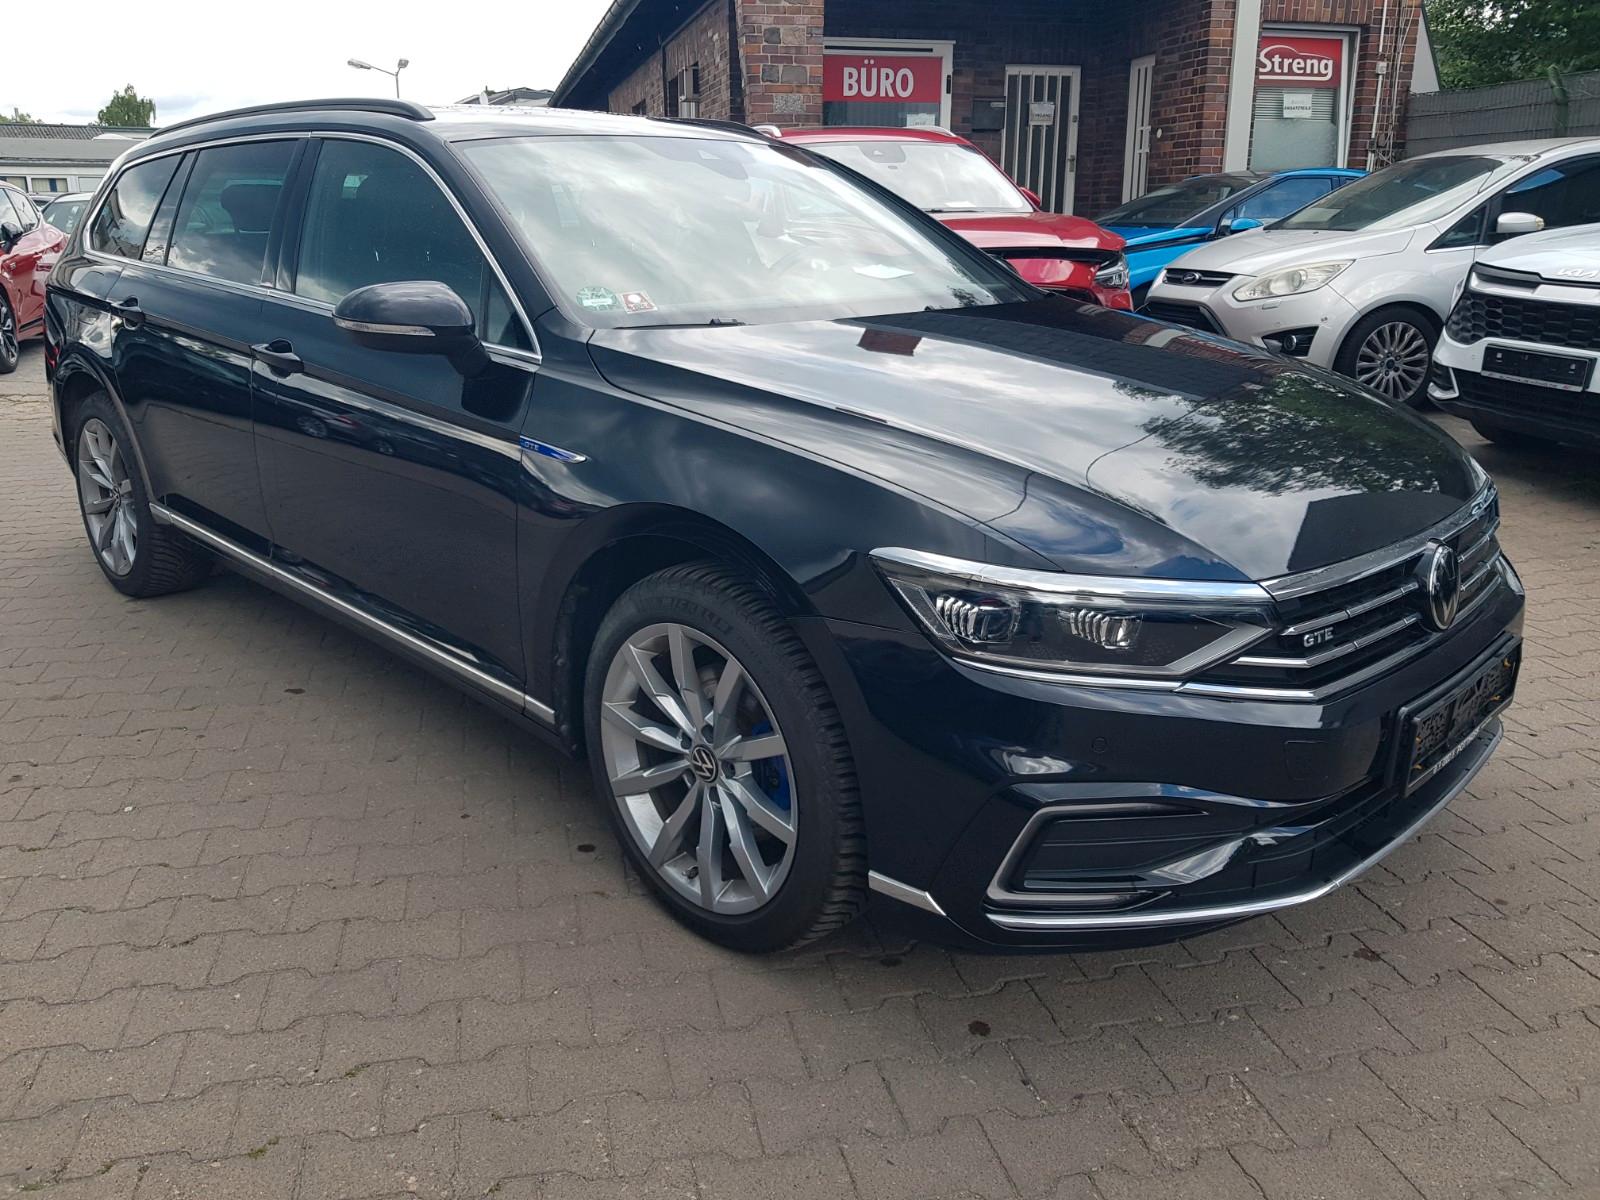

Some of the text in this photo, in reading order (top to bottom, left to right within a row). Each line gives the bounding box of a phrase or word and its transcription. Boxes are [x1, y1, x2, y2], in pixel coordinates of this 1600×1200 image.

[842, 58, 914, 98] BÜRO
[1258, 45, 1334, 81] Streng
[1303, 626, 1335, 648] GTE
